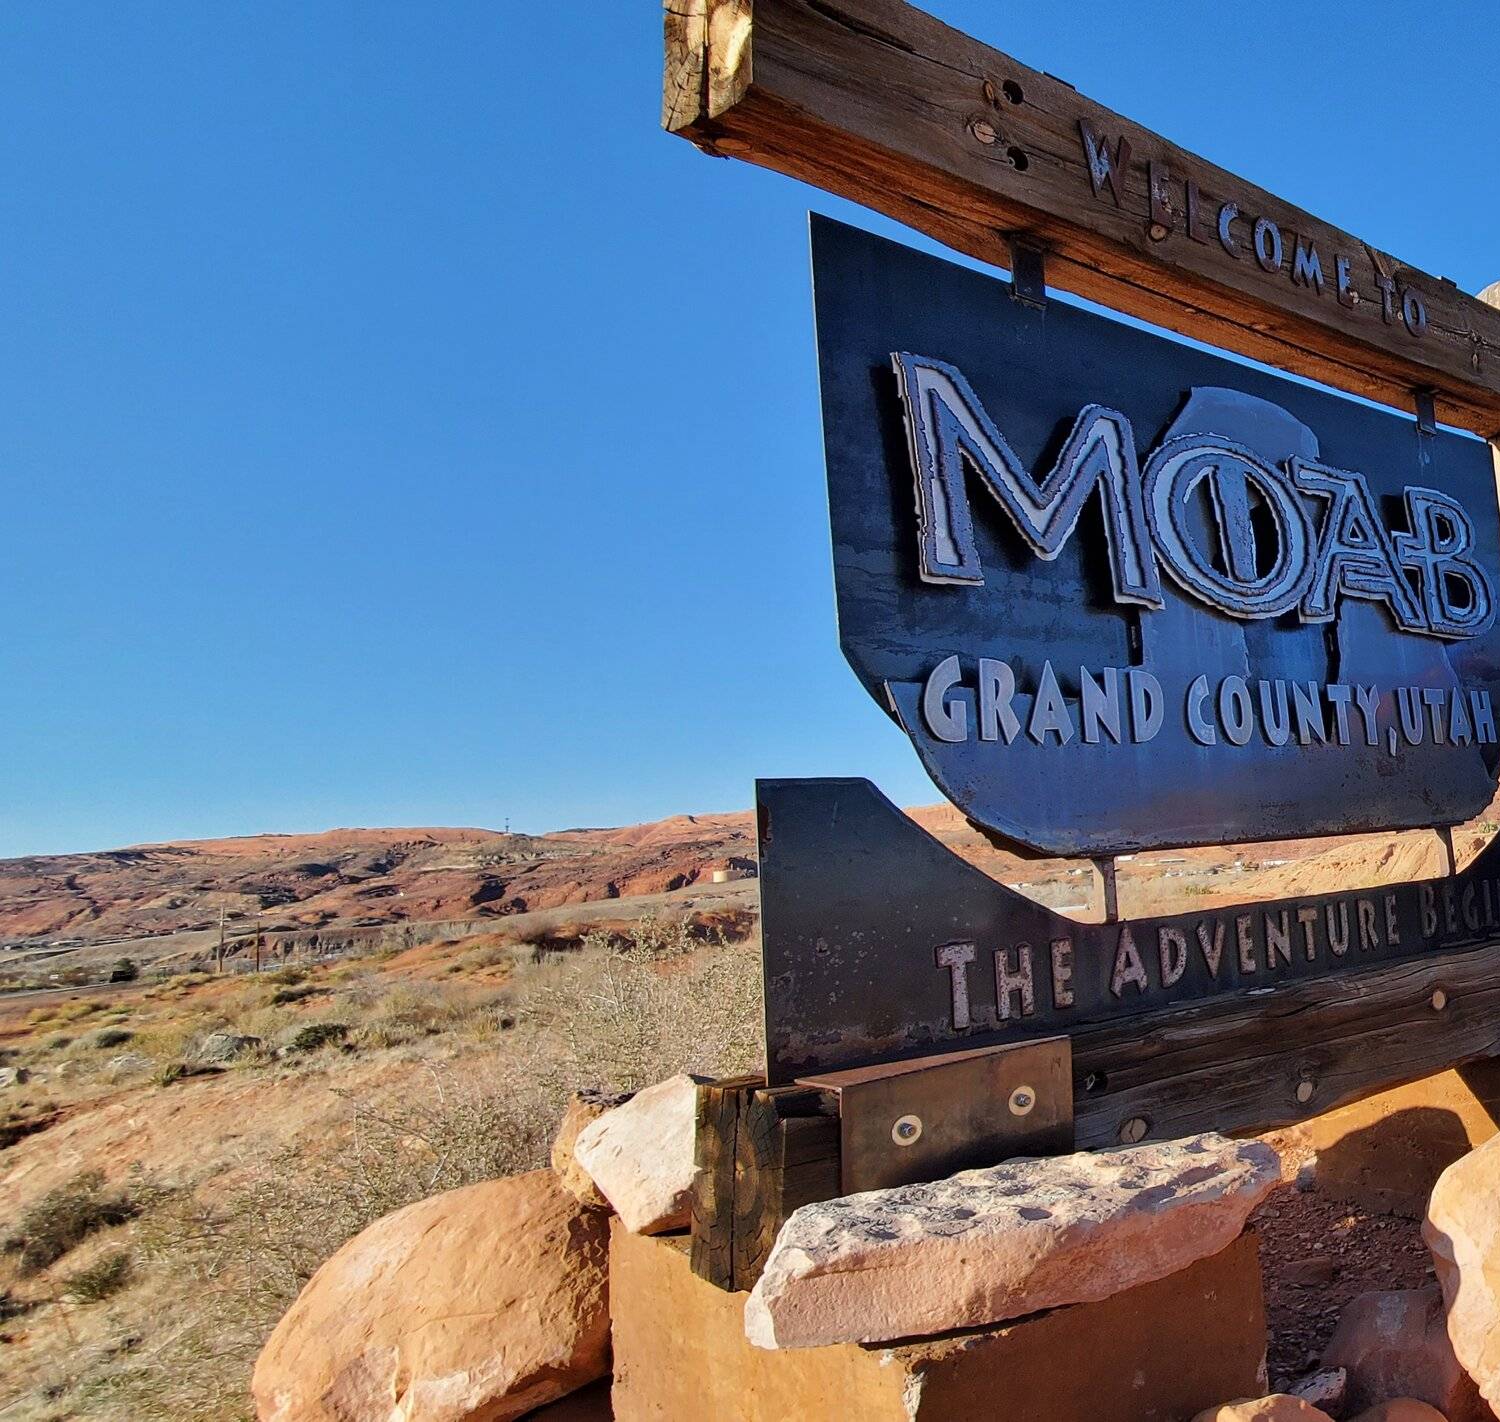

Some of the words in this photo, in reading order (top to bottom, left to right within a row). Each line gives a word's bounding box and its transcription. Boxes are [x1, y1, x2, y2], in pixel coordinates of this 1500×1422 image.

[1078, 118, 1356, 309] WELCOME
[1375, 271, 1429, 338] TO
[890, 351, 1497, 641] MOAB
[923, 654, 1165, 746] GRAND
[1398, 685, 1498, 747] UTAH
[935, 935, 1076, 1030] THE
[1110, 894, 1402, 998] ADVENTURE
